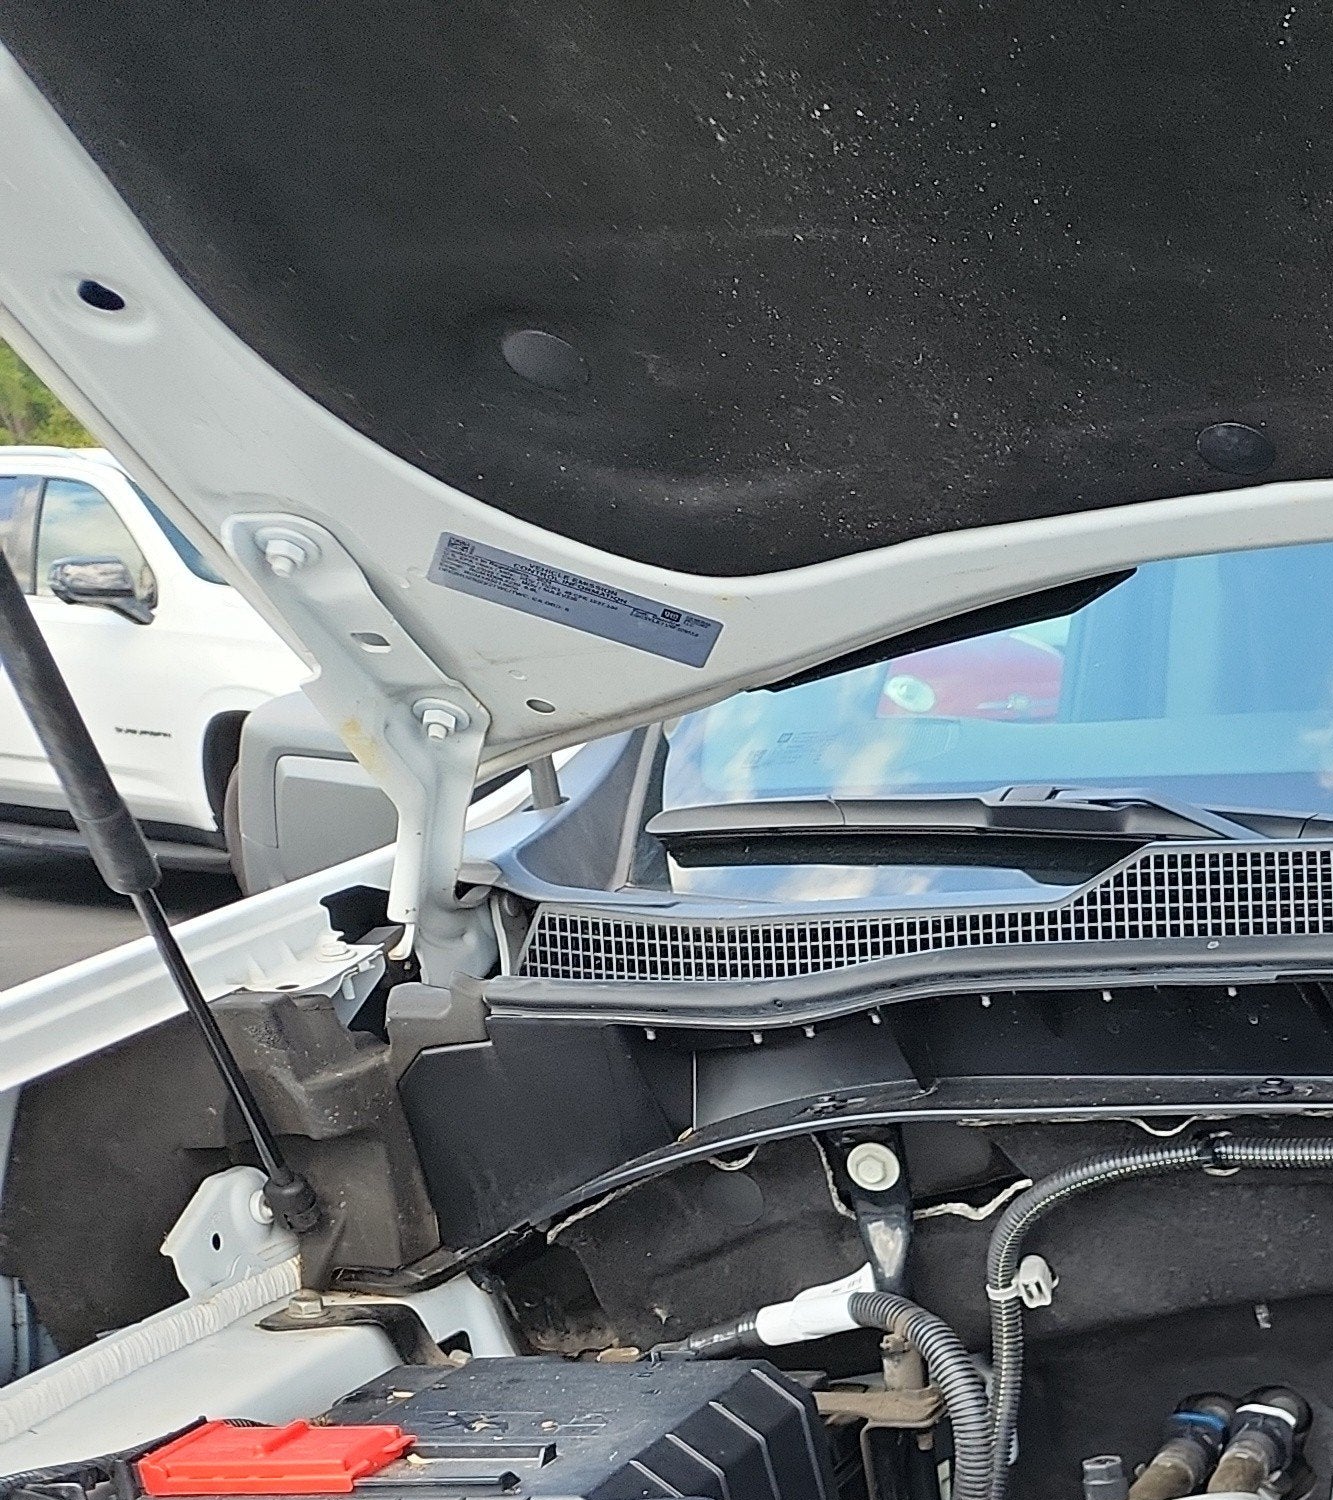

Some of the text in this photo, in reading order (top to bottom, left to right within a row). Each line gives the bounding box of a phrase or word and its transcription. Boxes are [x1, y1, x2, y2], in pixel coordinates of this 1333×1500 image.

[513, 562, 628, 604] CONTROL INFORMATION
[528, 562, 618, 597] VEHICLE EMISSION
